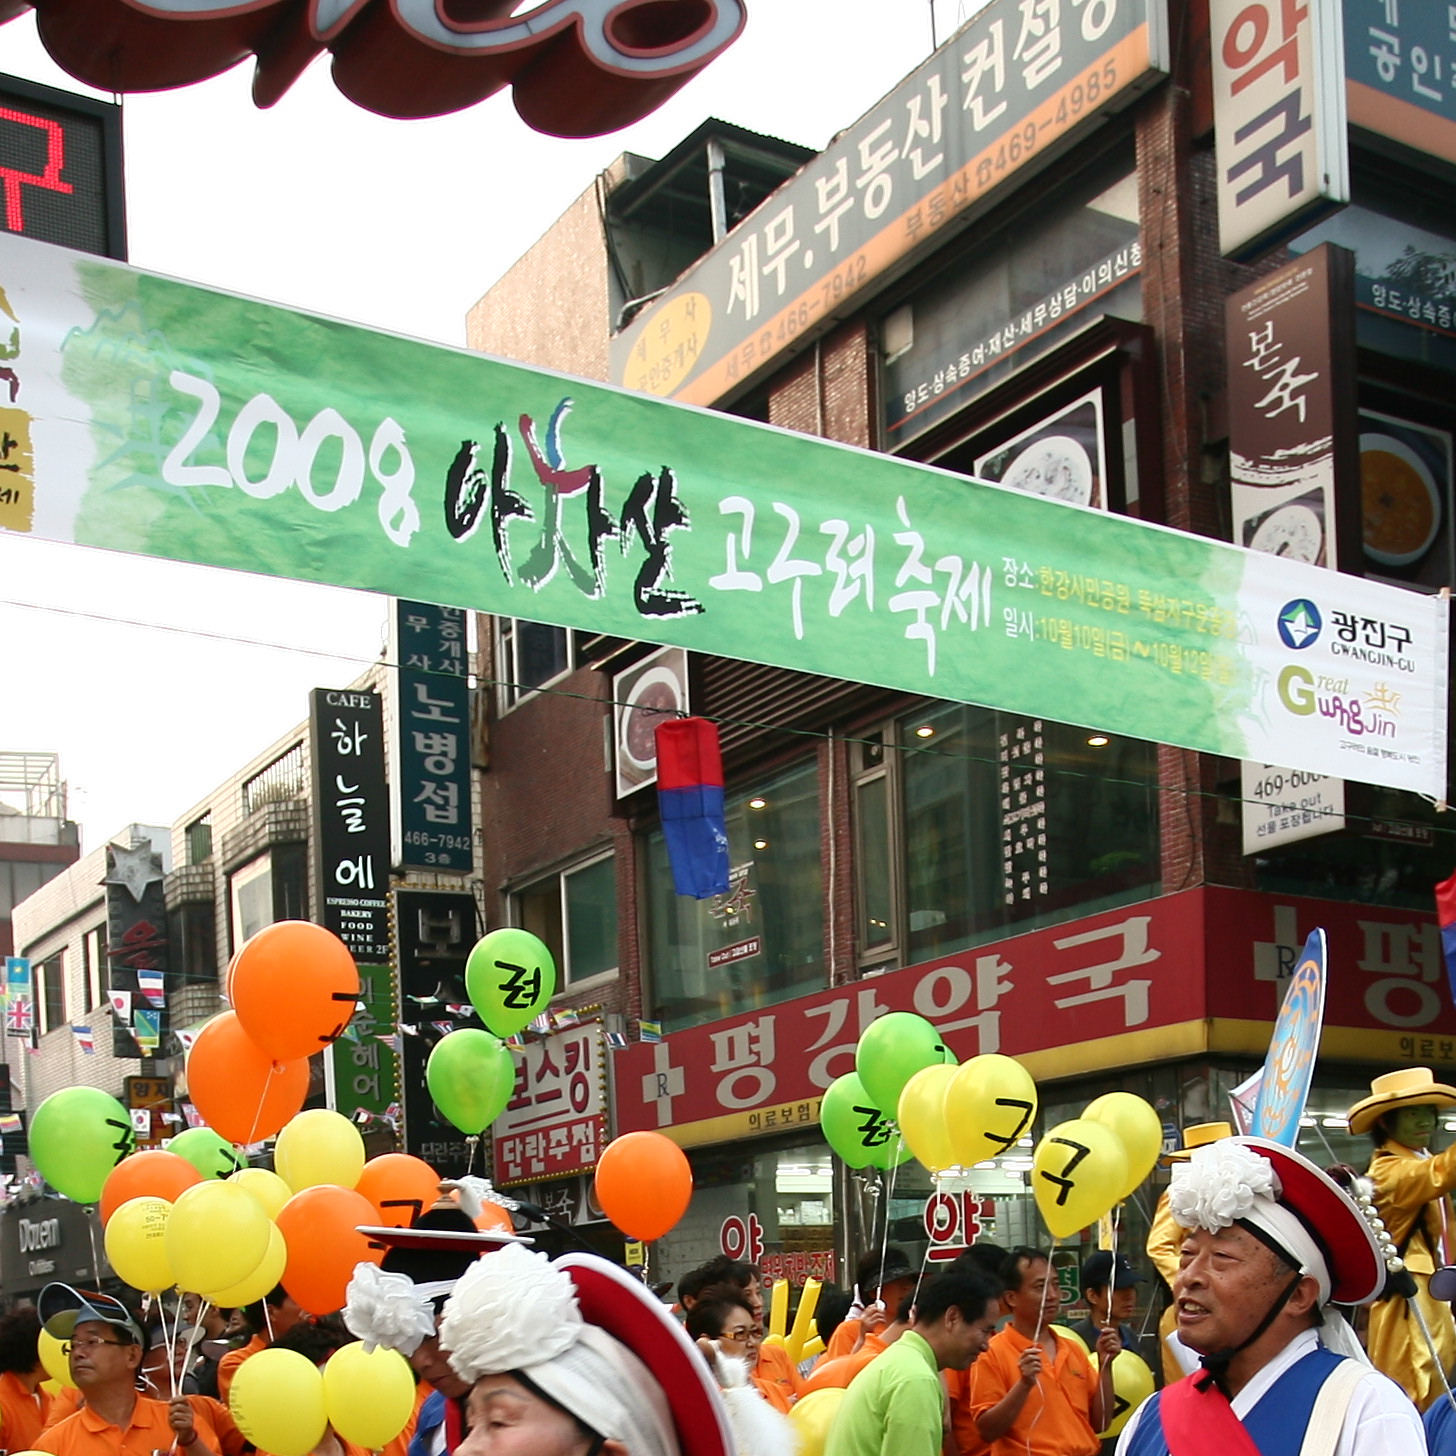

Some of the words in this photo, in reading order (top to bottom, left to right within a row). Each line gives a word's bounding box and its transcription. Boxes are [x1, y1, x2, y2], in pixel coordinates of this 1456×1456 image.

[1221, 0, 1313, 207] 약국
[1242, 320, 1320, 425] 본죽
[161, 369, 423, 547] 2008
[442, 397, 706, 620] 아차산
[708, 496, 875, 640] 고구려
[892, 496, 992, 677] 축제
[1330, 608, 1415, 655] 광진구
[1329, 641, 1417, 675] GWANGJIN-GU
[325, 691, 372, 710] CAFE
[410, 682, 461, 826] 노병섭
[1253, 769, 1330, 800] 469-60
[330, 717, 375, 890] 하늘에
[1266, 800, 1296, 819] Take
[1299, 792, 1323, 809] out
[403, 830, 471, 852] 466-7942
[340, 920, 374, 931] FOOD
[340, 932, 374, 943] WINE
[502, 1125, 595, 1178] 단란주점
[18, 1216, 61, 1253] Dozen
